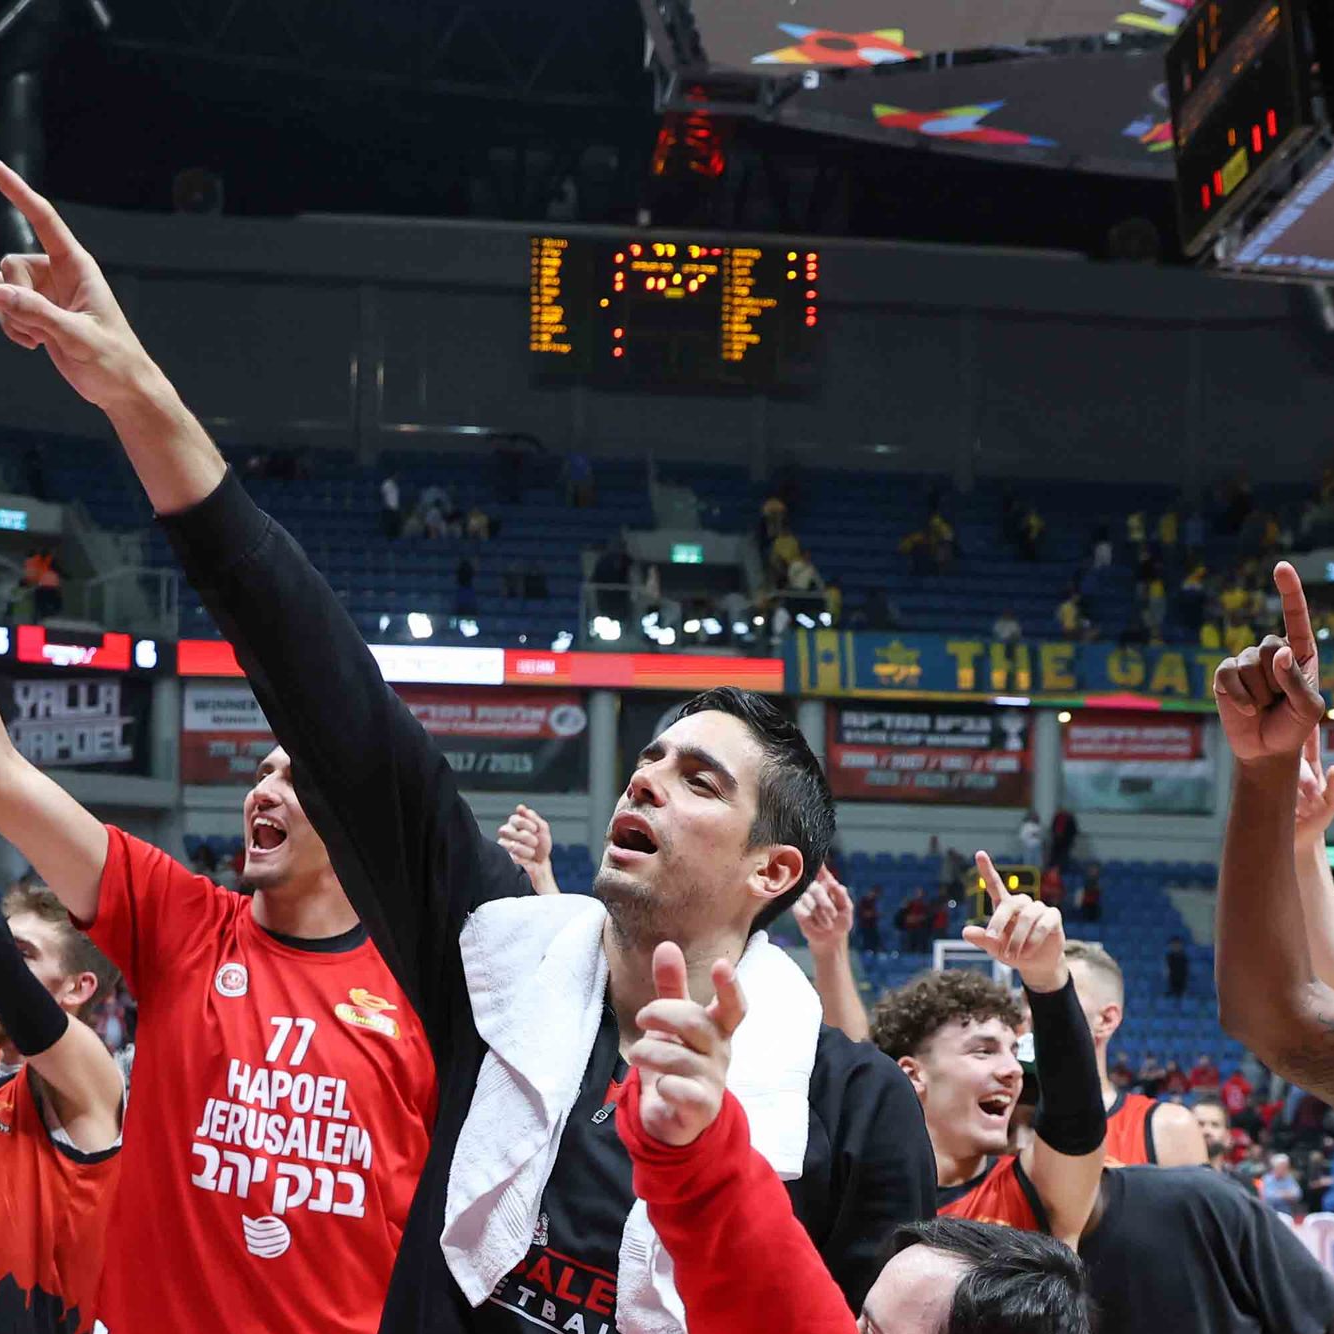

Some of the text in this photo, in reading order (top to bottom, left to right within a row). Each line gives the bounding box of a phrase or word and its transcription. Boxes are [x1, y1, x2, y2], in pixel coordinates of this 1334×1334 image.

[135, 640, 158, 669] 6
[947, 640, 1075, 692] THE
[13, 682, 121, 720] YALLA
[265, 1016, 317, 1067] 77
[227, 1059, 351, 1121] HAPOEL
[195, 1098, 373, 1171] JERUSALEM
[191, 1142, 366, 1219] בנק יהב
[513, 1254, 617, 1317] ALE
